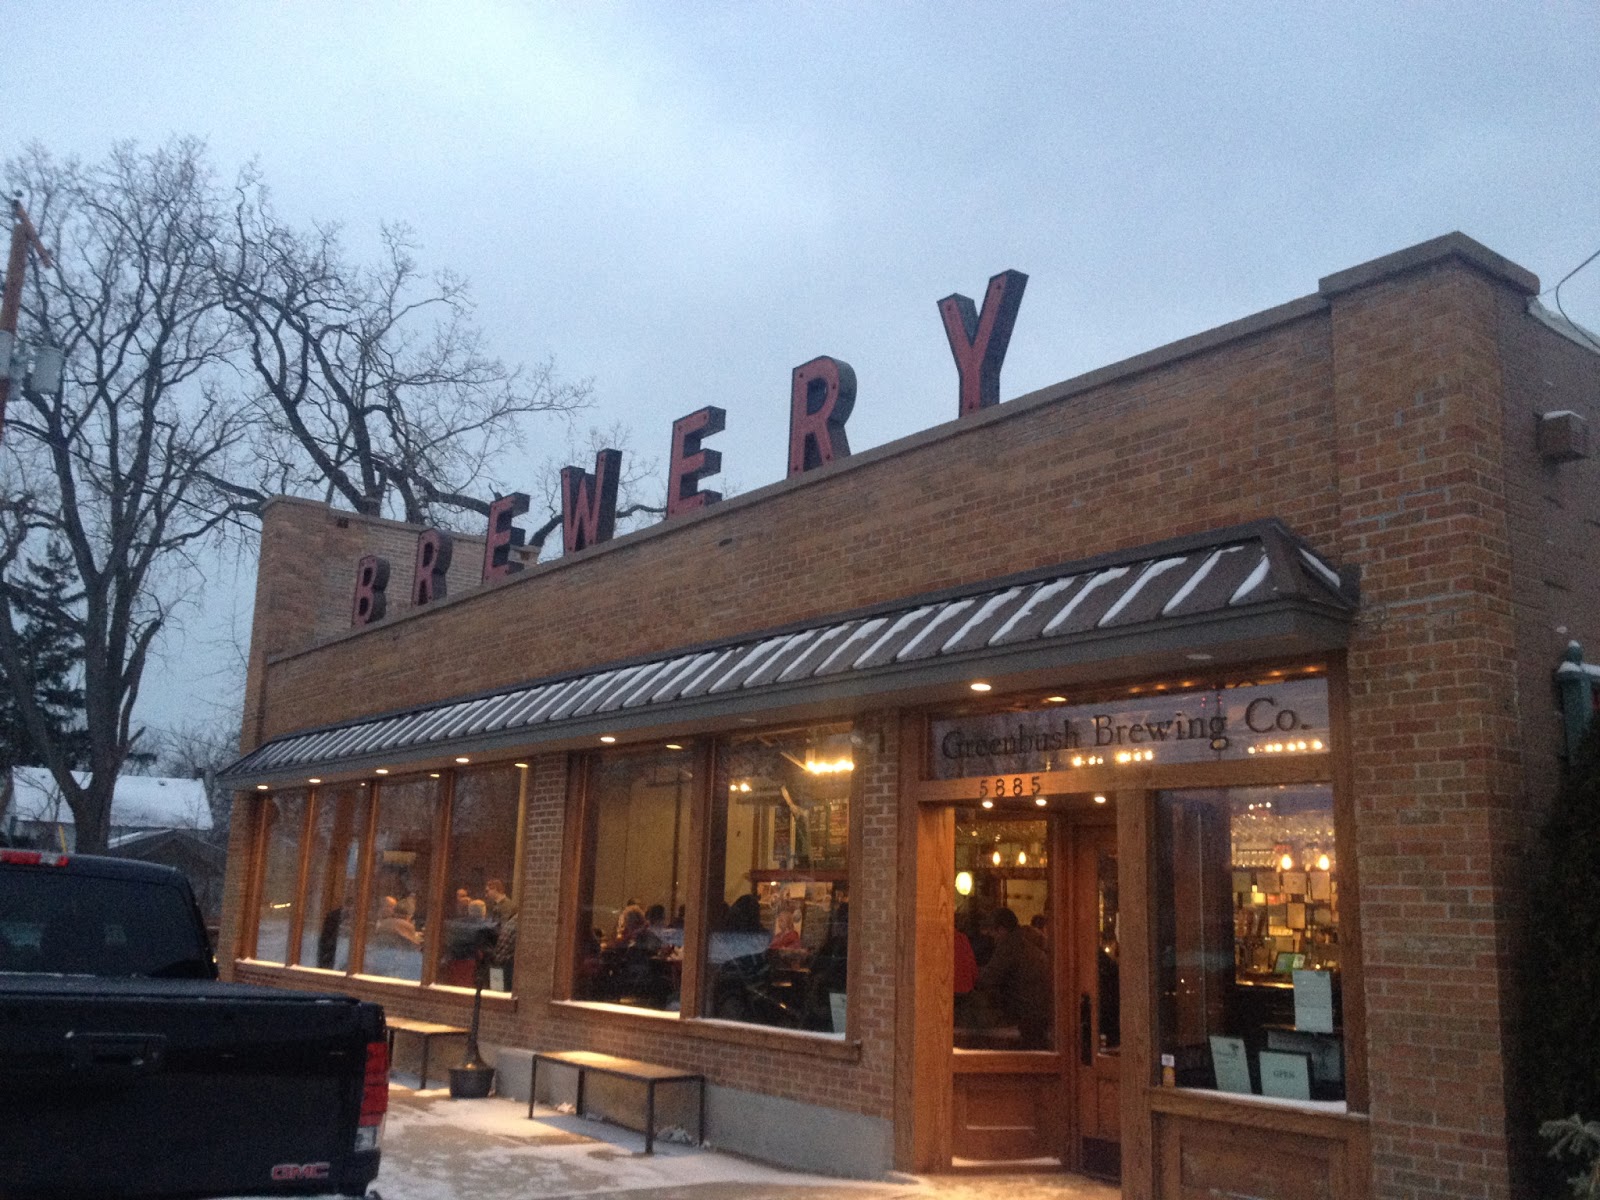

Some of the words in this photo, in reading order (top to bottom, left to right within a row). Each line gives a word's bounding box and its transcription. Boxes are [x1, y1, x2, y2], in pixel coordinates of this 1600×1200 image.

[352, 269, 1028, 627] BREWERY
[941, 719, 1080, 760] Greenbush
[1092, 709, 1228, 752] Brewing
[1244, 697, 1313, 735] Co.
[978, 775, 1042, 798] 5885
[271, 1161, 331, 1181] GMC
